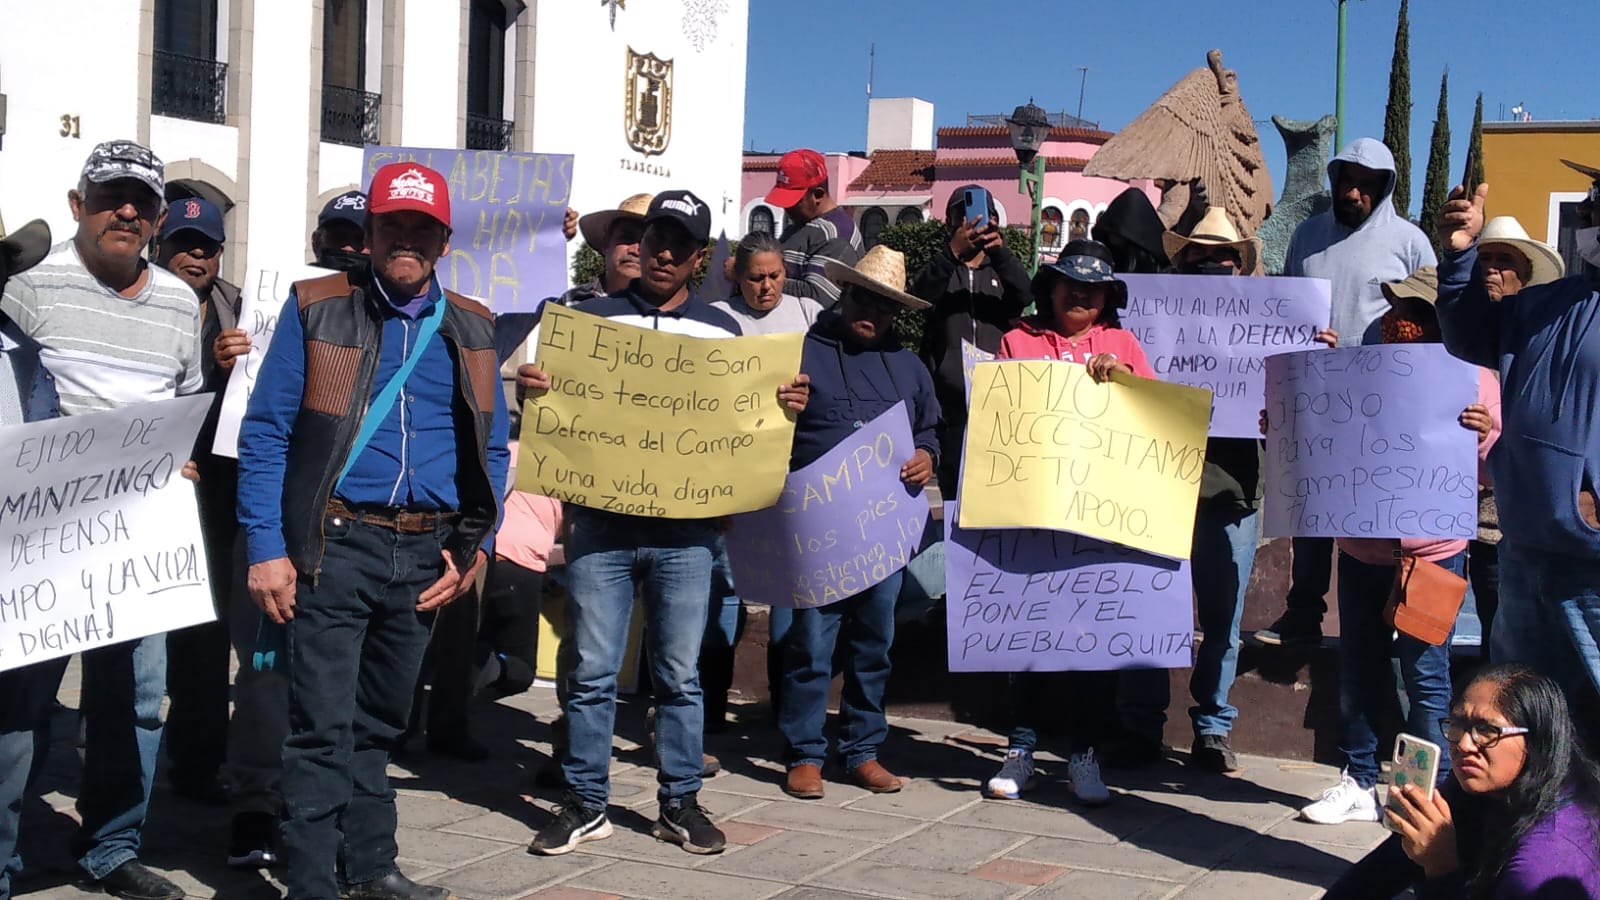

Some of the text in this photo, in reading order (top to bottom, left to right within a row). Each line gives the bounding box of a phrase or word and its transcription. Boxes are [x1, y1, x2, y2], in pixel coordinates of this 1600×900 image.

[59, 114, 80, 138] 31
[449, 152, 571, 206] ABEJAS
[620, 159, 671, 178] TLAXCALA
[184, 200, 200, 218] B
[473, 208, 544, 252] HAY
[1118, 296, 1291, 318] ALPULALPAN SE
[541, 312, 761, 377] El Ejido de San
[1129, 323, 1318, 346] NE A LA DEFENSA
[1154, 353, 1217, 374] CAMPO
[541, 361, 604, 400] ucas
[734, 393, 761, 412] en
[982, 363, 1111, 419] AMLO
[15, 417, 165, 473] EJIDO DE
[639, 431, 664, 452] del
[989, 411, 1204, 485] NECESITAMOS
[1360, 424, 1415, 457] los
[533, 452, 734, 505] Y una vida digna
[986, 450, 1090, 487] DE TU
[10, 509, 130, 571] DEFENSA
[795, 530, 837, 554] los
[897, 516, 921, 541] la
[108, 558, 140, 595] LA
[963, 569, 1174, 600] EL PUEBLO
[19, 600, 114, 657] DIGNA!
[962, 599, 1137, 628] PONE Y EL
[962, 630, 1195, 660] PUEBLO QUITA
